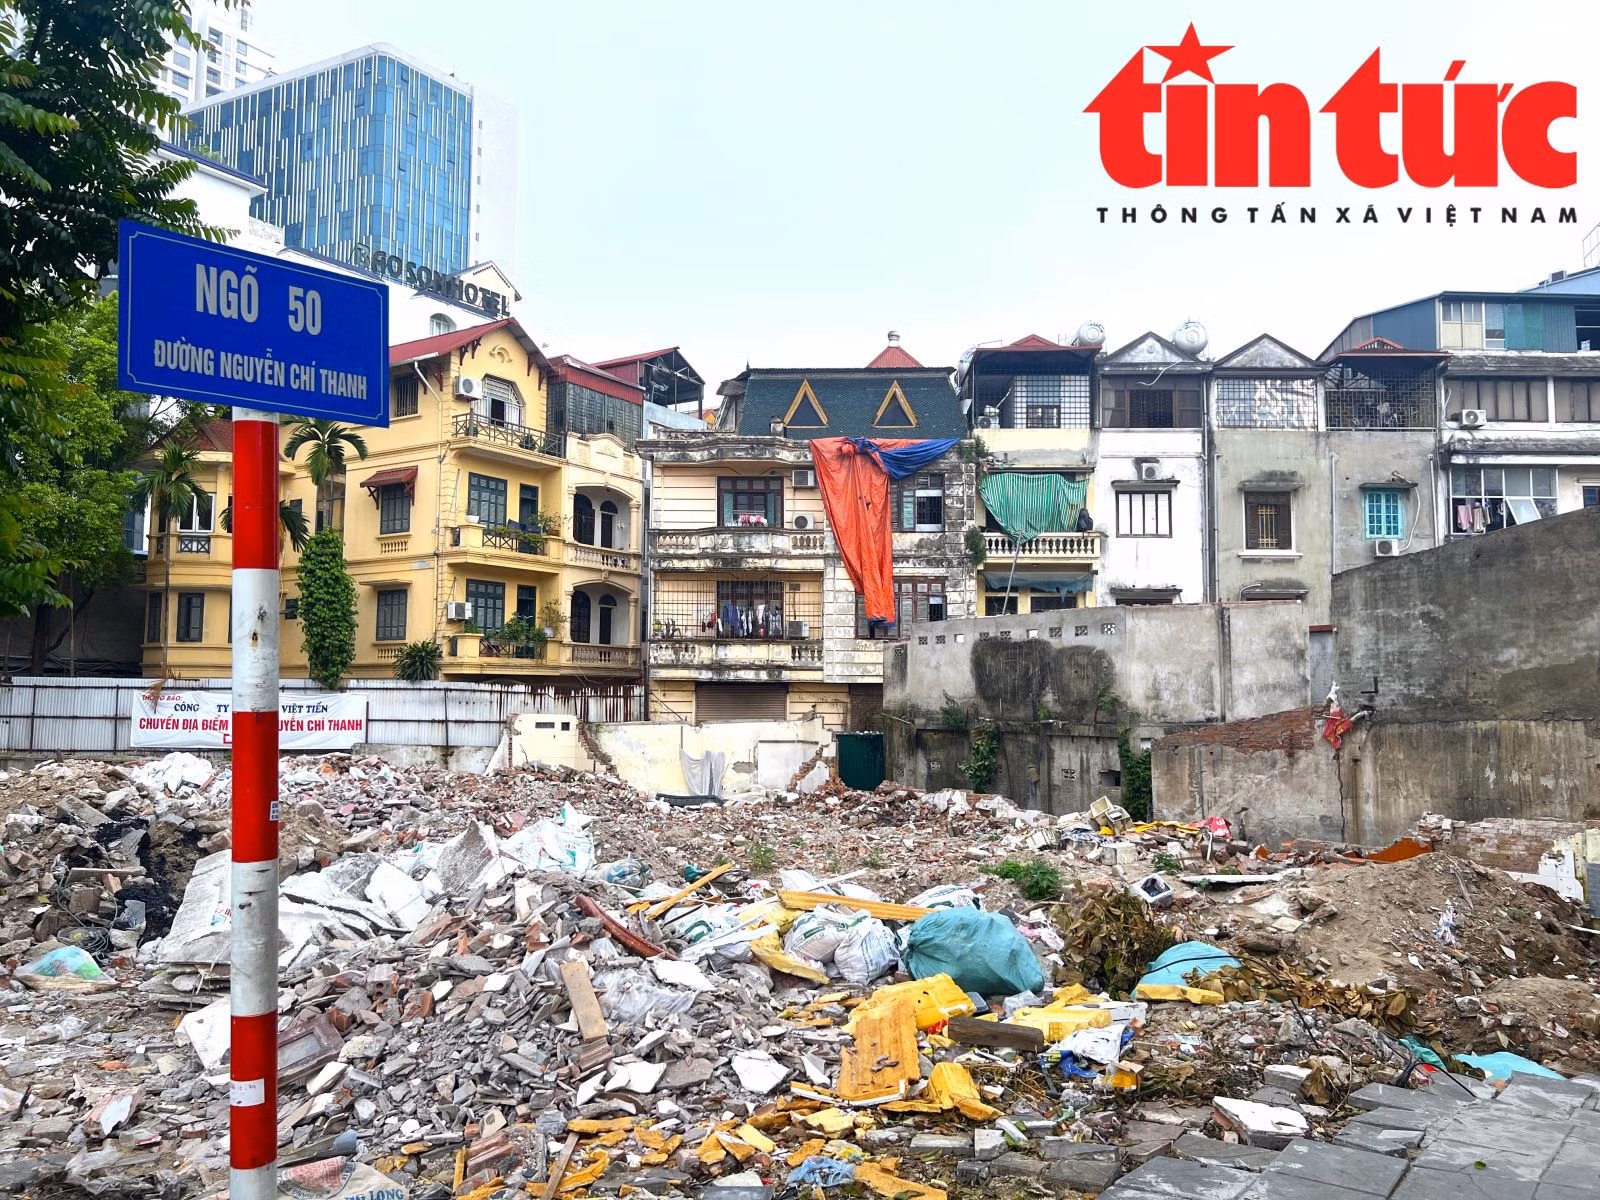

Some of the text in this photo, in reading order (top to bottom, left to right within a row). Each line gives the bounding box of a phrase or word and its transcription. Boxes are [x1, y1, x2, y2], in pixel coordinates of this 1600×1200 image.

[195, 263, 322, 336] NGÕ 50
[354, 242, 403, 278] BAO
[449, 276, 510, 317] HOTEL
[154, 336, 368, 400] ĐƯỜNG NGUYỄN CHÍ THANH
[174, 701, 328, 714] CÔNG TY VIỆT TIẾN
[182, 718, 199, 733] ĐỊA
[307, 717, 325, 731] CHÍ
[328, 719, 363, 731] THANH
